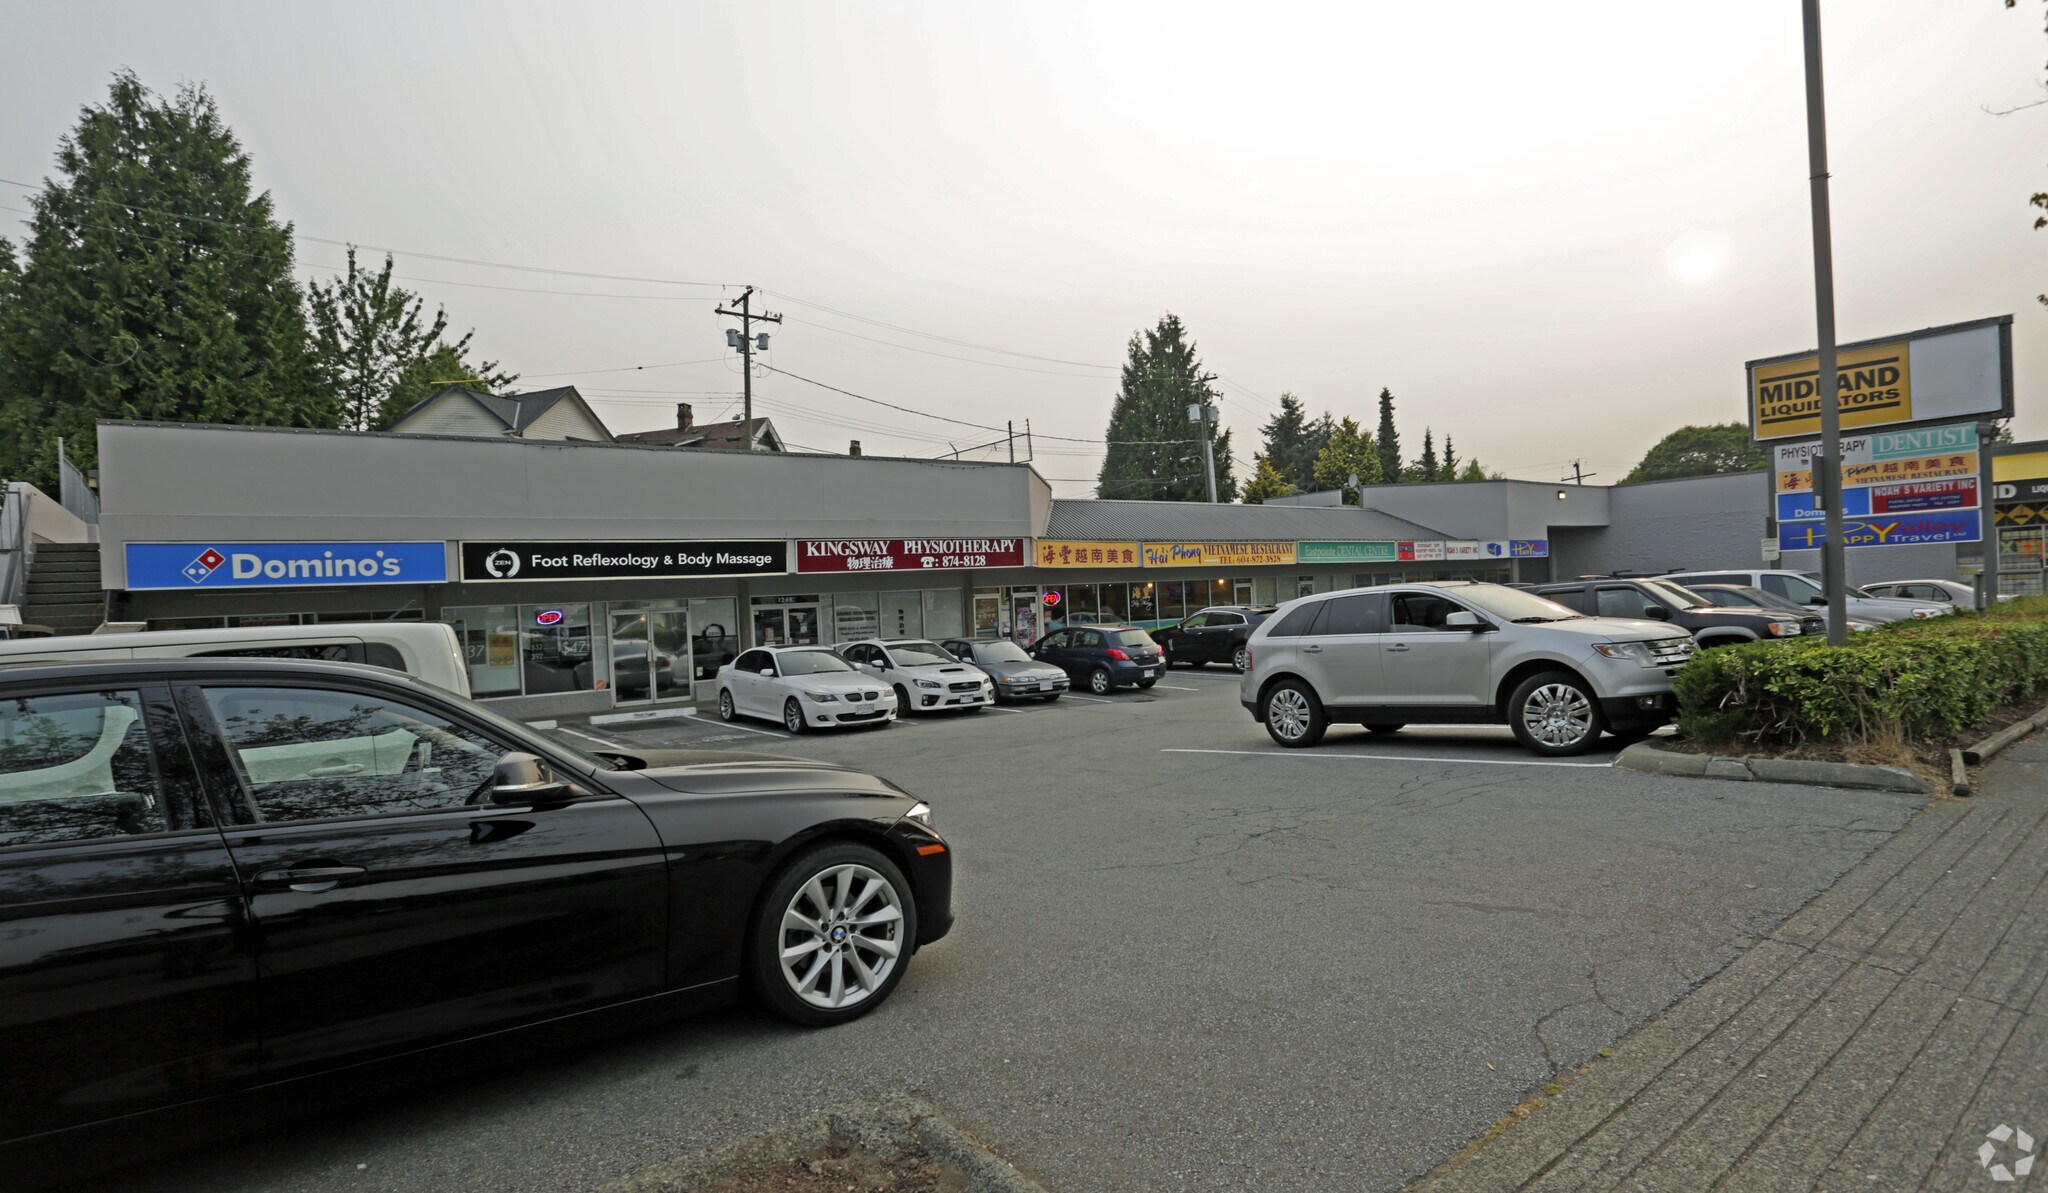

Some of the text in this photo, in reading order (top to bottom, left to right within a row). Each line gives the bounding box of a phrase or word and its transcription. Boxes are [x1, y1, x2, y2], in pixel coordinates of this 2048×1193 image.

[1760, 366, 1900, 405] MIDAND
[1761, 388, 1900, 418] LIQUITORS
[1879, 426, 1971, 453] DENTIST
[1781, 439, 1866, 459] PHYSIOTRAPY
[1855, 467, 1969, 484] VIETNAMESE RESTAURANT
[1913, 481, 1955, 494] VARIETY
[1957, 479, 1976, 490] INC
[1795, 507, 1849, 518] Domis
[1890, 532, 1950, 543] Travel
[806, 539, 1016, 557] KINGSWAY PHYSIOTHERAPY
[1203, 542, 1293, 556] VIETNAMESE RESTAURANT
[1337, 545, 1363, 556] DENTAL
[1364, 545, 1389, 556] CENTRE
[231, 550, 401, 579] Domino's
[531, 552, 772, 569] Foot Reflexology & Body Massage
[942, 555, 986, 568] 874-8128
[1042, 593, 1059, 603] OPEN
[538, 611, 561, 623] OPEN
